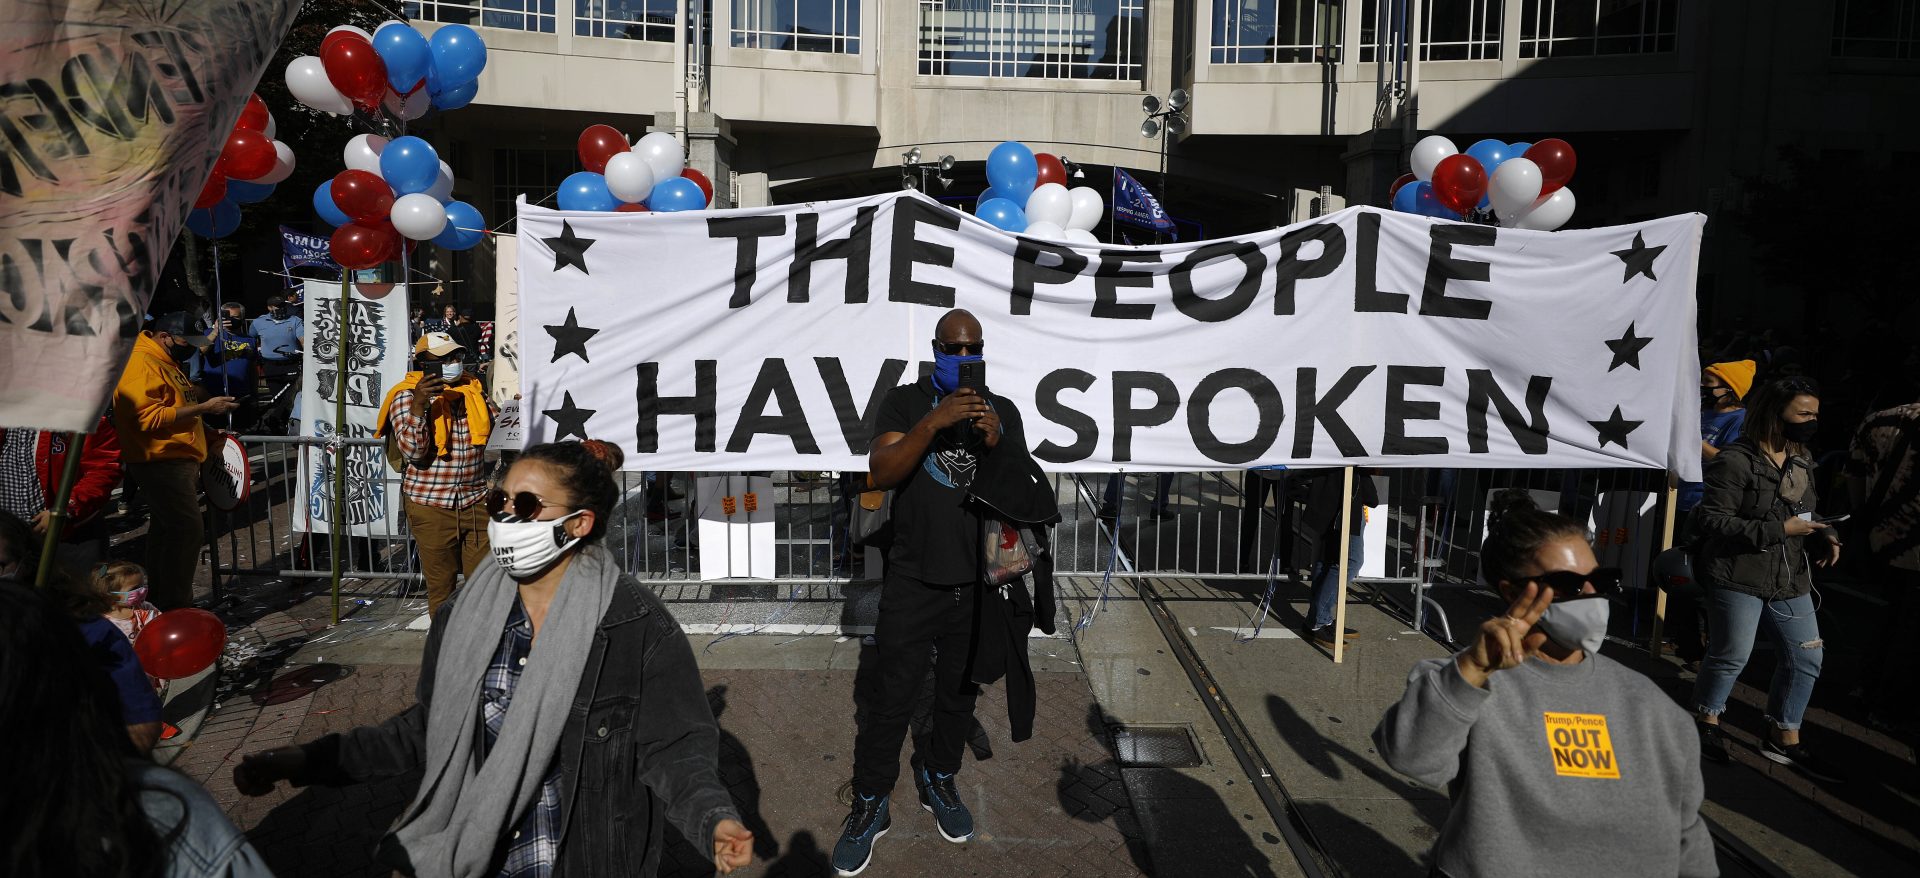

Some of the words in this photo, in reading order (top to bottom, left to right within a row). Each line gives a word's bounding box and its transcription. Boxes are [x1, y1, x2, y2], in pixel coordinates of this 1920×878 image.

[707, 196, 961, 309] THE
[1010, 211, 1497, 323] PEOPLE
[636, 356, 934, 456] HAV
[1030, 363, 1552, 465] SPOKEN
[493, 546, 514, 556] UNT
[496, 556, 515, 566] ERY
[1545, 714, 1605, 727] Trump/Pence
[1553, 727, 1601, 749] OUT
[1554, 747, 1611, 770] NOW
